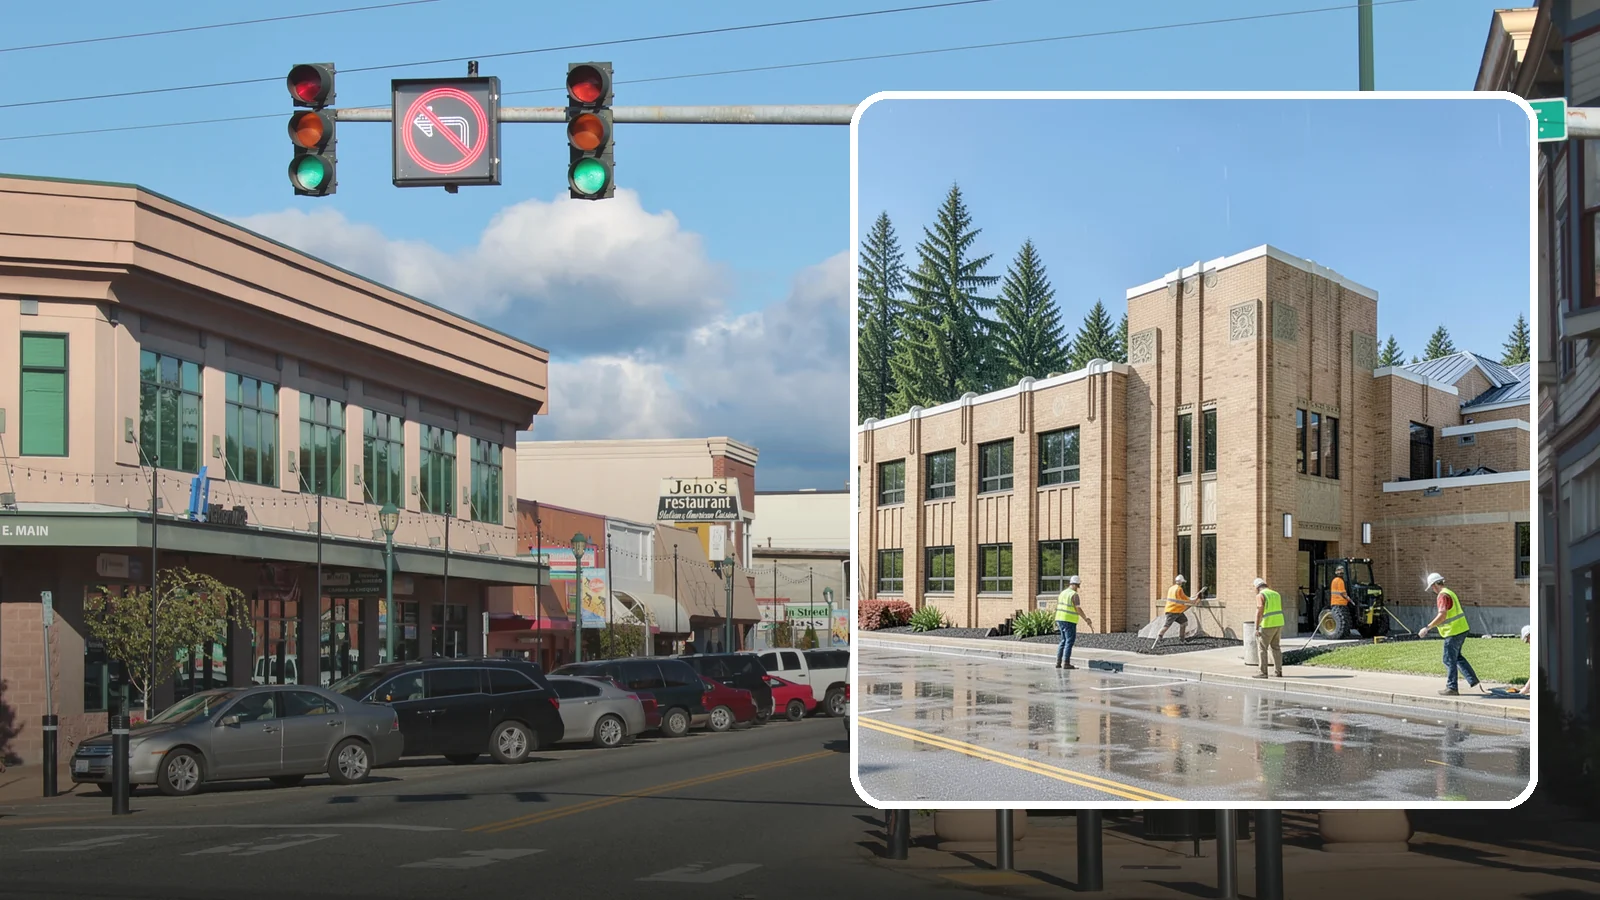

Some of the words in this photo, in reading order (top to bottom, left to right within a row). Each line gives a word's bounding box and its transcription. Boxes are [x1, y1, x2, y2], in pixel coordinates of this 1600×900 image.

[669, 479, 728, 495] Jeno's
[665, 496, 731, 509] restaurant
[686, 509, 714, 519] American
[715, 509, 738, 519] Cuisine
[2, 525, 13, 536] E.
[15, 525, 49, 536] MAIN
[797, 608, 828, 616] Street
